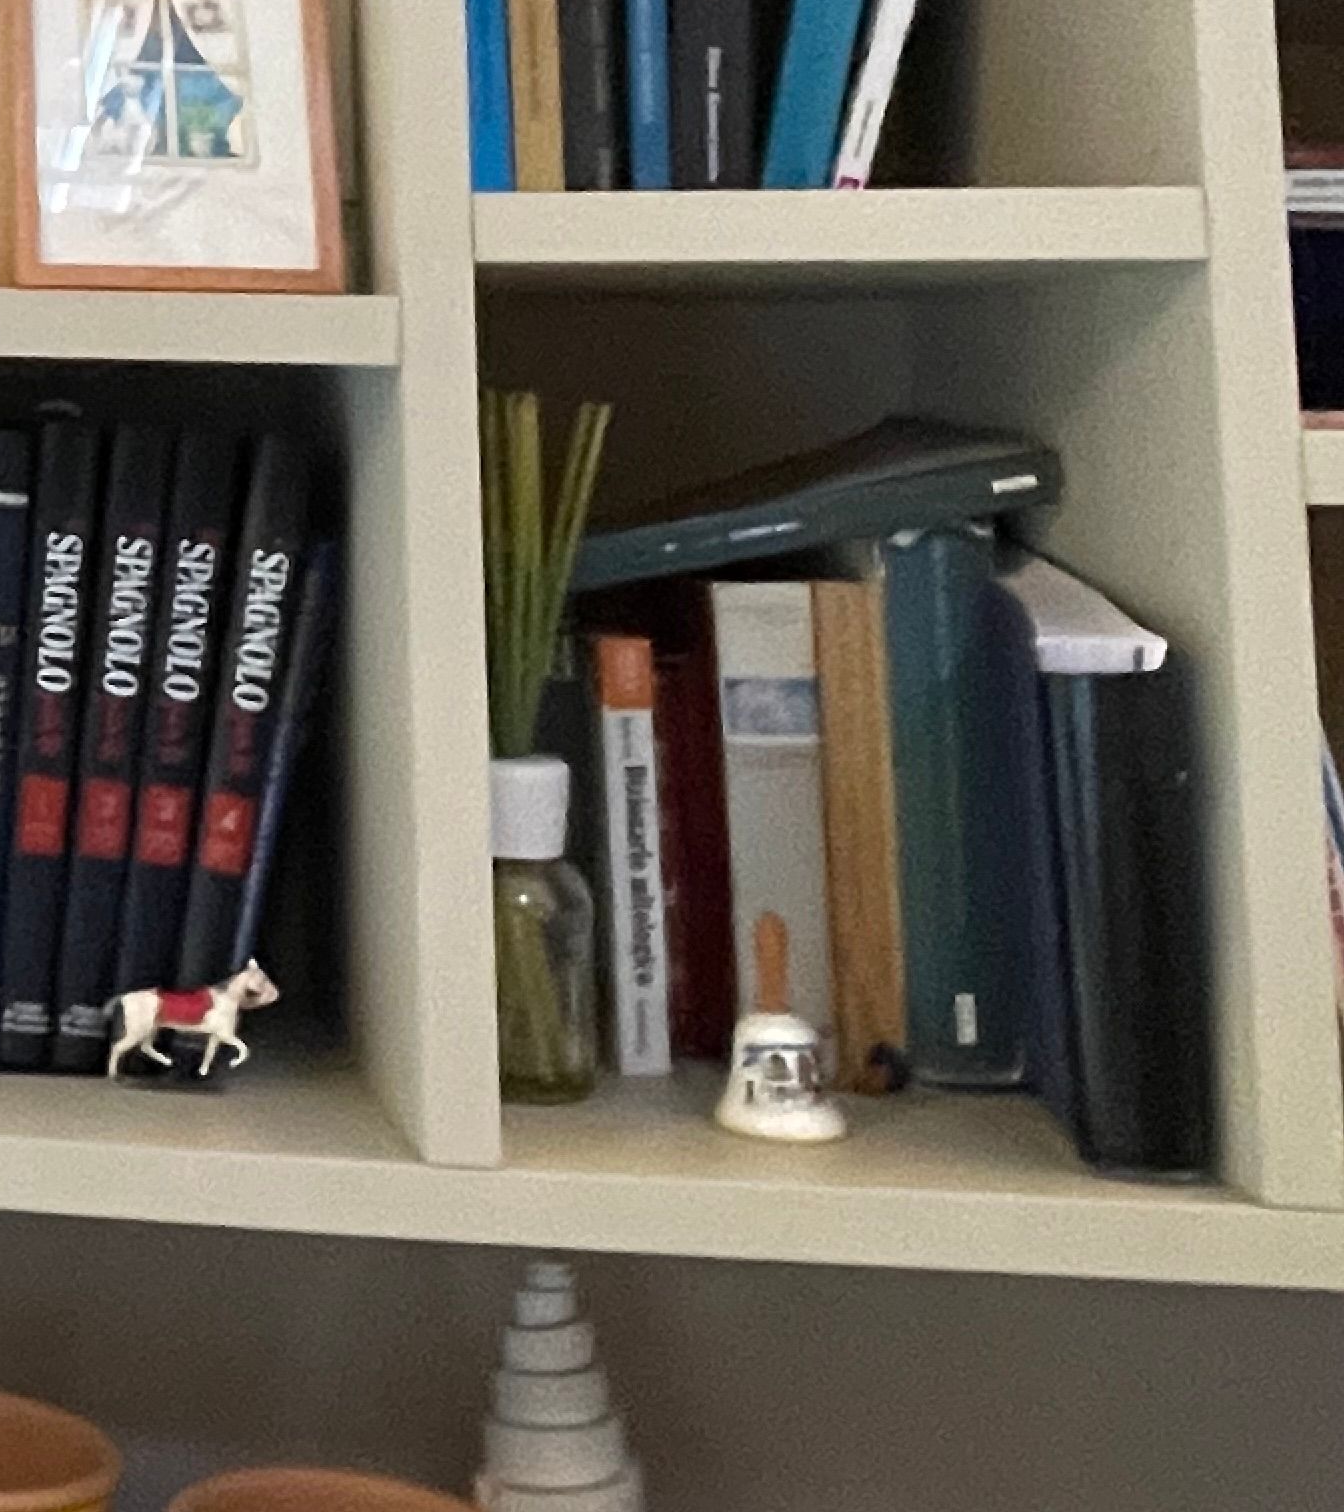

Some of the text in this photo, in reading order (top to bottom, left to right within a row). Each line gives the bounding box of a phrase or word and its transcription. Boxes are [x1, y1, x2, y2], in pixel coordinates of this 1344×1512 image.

[36, 532, 84, 693] SPAGNOLO
[102, 535, 155, 698] SPAGNOLO
[163, 538, 216, 702] SPAGNOLO
[232, 548, 290, 713] SPAGNOLO
[624, 763, 657, 988] Dizionario mitologico
